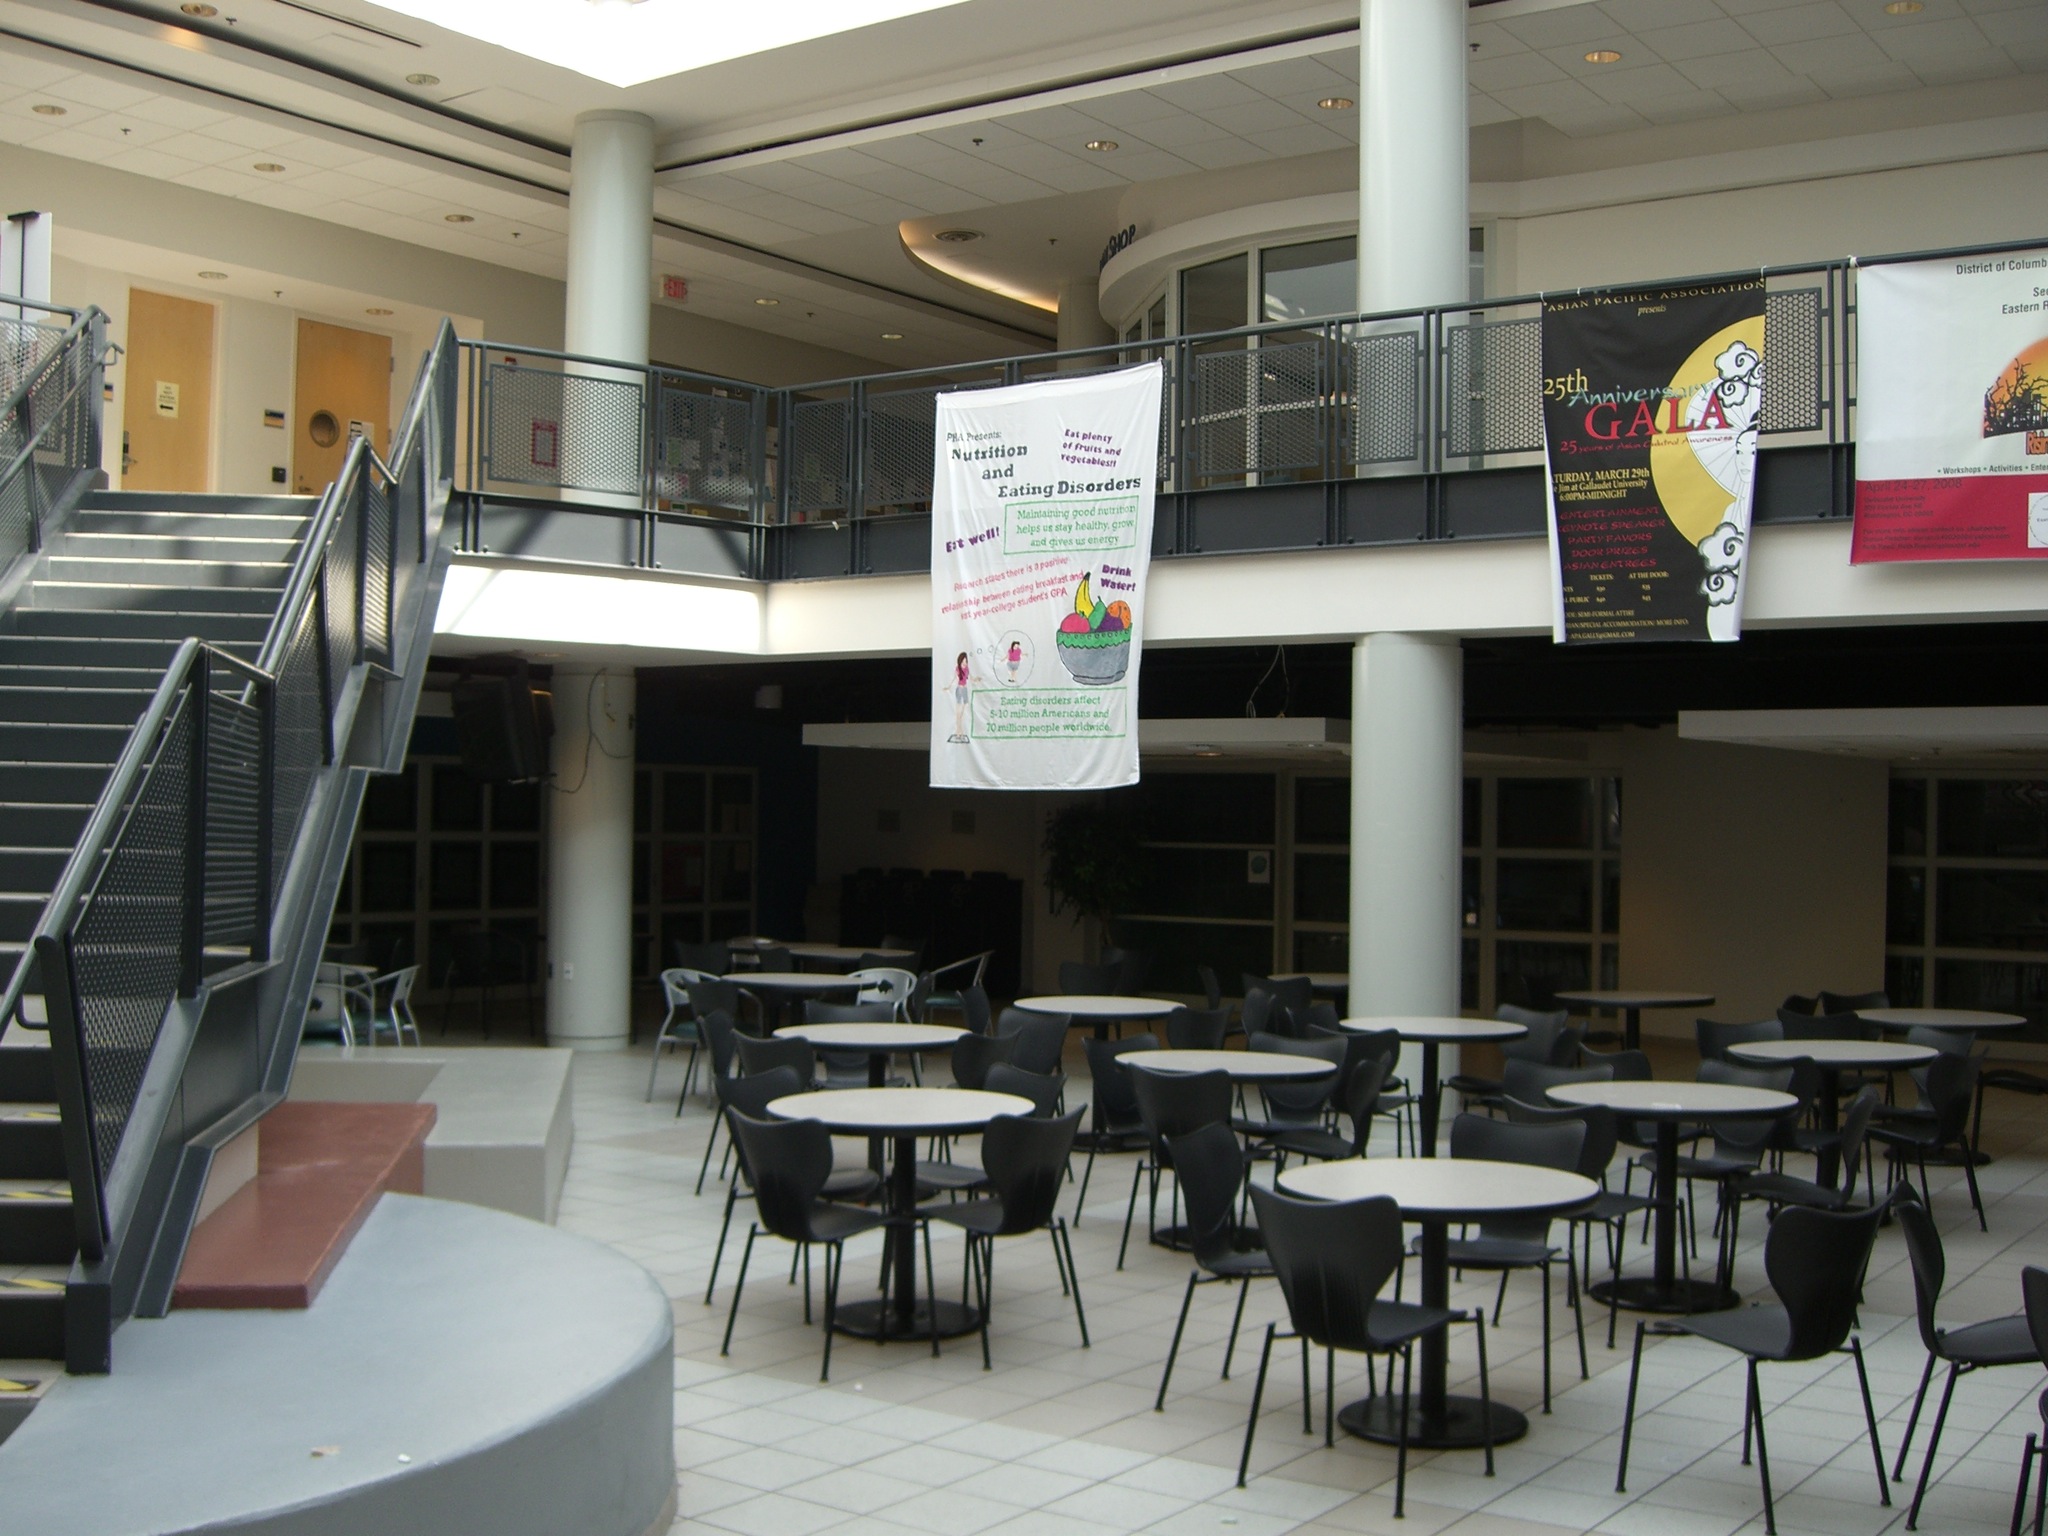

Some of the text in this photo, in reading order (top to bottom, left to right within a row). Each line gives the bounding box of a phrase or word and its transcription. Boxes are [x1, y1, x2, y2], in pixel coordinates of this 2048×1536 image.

[1956, 258, 2048, 275] District of Columb
[1548, 280, 1766, 313] ASIAN PACIFIC ASSOCIATION
[1637, 304, 1667, 317] presents
[2002, 303, 2040, 315] Eastern
[1544, 368, 1589, 400] 25th
[1568, 382, 1715, 407] Anniversary
[1585, 391, 1733, 441] GALA
[966, 430, 1002, 441] Presents:
[1064, 428, 1112, 444] Eat plenty
[951, 445, 1028, 462] Nutrition
[1062, 441, 1122, 456] of fruits and
[1560, 440, 1577, 454] 25
[1060, 453, 1117, 468] vegetables!!
[981, 464, 1014, 480] and
[1553, 468, 1650, 484] TURDAY, MARCH 29th
[1943, 467, 1981, 475] Workshops
[1989, 464, 2023, 472] Activities
[998, 477, 1141, 498] Eating Disorders
[1579, 481, 1612, 491] Gallaudet
[1613, 479, 1648, 489] University
[1866, 481, 1890, 493] April
[1933, 478, 1962, 490] 2008
[1017, 504, 1136, 521] Maintaining good nutrition
[1560, 506, 1659, 520] ENTERTAINMENT
[1016, 524, 1041, 536] helps
[1043, 524, 1054, 533] us
[1055, 522, 1073, 534] stay
[1112, 519, 1135, 530] grow
[1611, 520, 1665, 530] SPEAKER
[946, 527, 1000, 553] Eat well!
[1030, 535, 1119, 548] and gives us energy
[1568, 533, 1653, 545] PARTY FAVORS
[1571, 546, 1648, 557] DOOR PRIZES
[1006, 567, 1026, 579] there
[1026, 563, 1034, 573] is
[1564, 559, 1657, 571] ASIAN ENTREES
[1100, 565, 1136, 592] Drink Water!
[1637, 571, 1648, 579] THE
[982, 589, 1011, 603] between
[1012, 582, 1034, 597] eating
[1035, 574, 1069, 589] breakfast
[1069, 569, 1085, 582] and
[1017, 591, 1049, 607] student's
[1050, 586, 1069, 598] GPA
[1001, 695, 1101, 707] Eating disorders affect
[990, 708, 1110, 719] 5-10 million Americans and
[998, 722, 1027, 733] million
[1029, 723, 1060, 734] people
[1063, 722, 1112, 732] worldwide.
